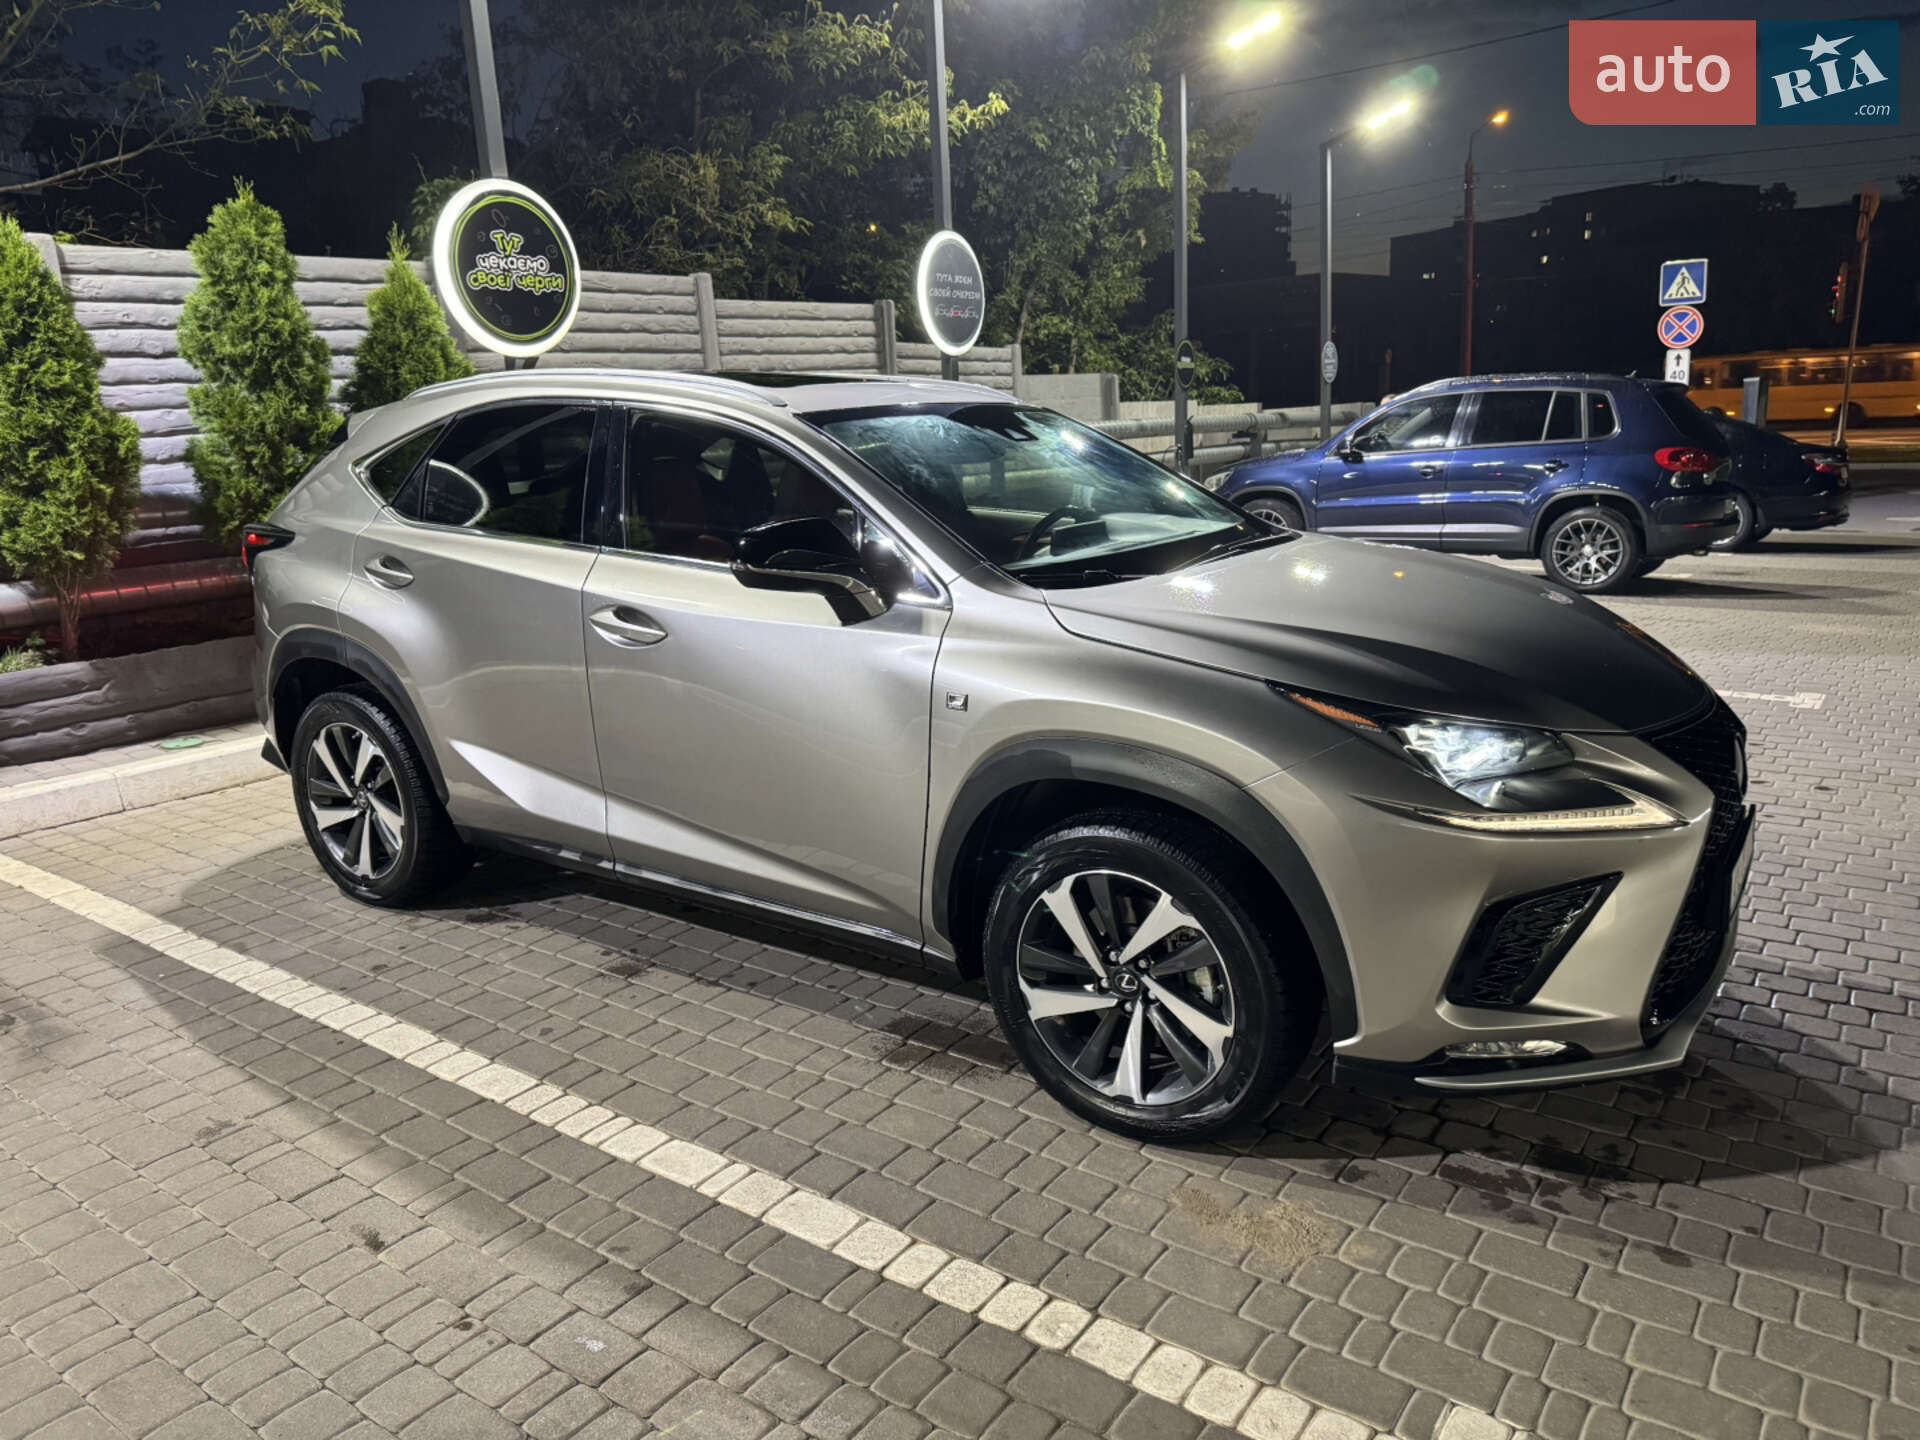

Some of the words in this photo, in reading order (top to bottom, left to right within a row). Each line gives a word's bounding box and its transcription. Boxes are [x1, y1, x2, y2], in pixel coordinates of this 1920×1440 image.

[477, 256, 548, 272] чекаємо
[468, 270, 513, 289] своєї
[515, 274, 564, 293] черги
[1669, 369, 1686, 381] 40
